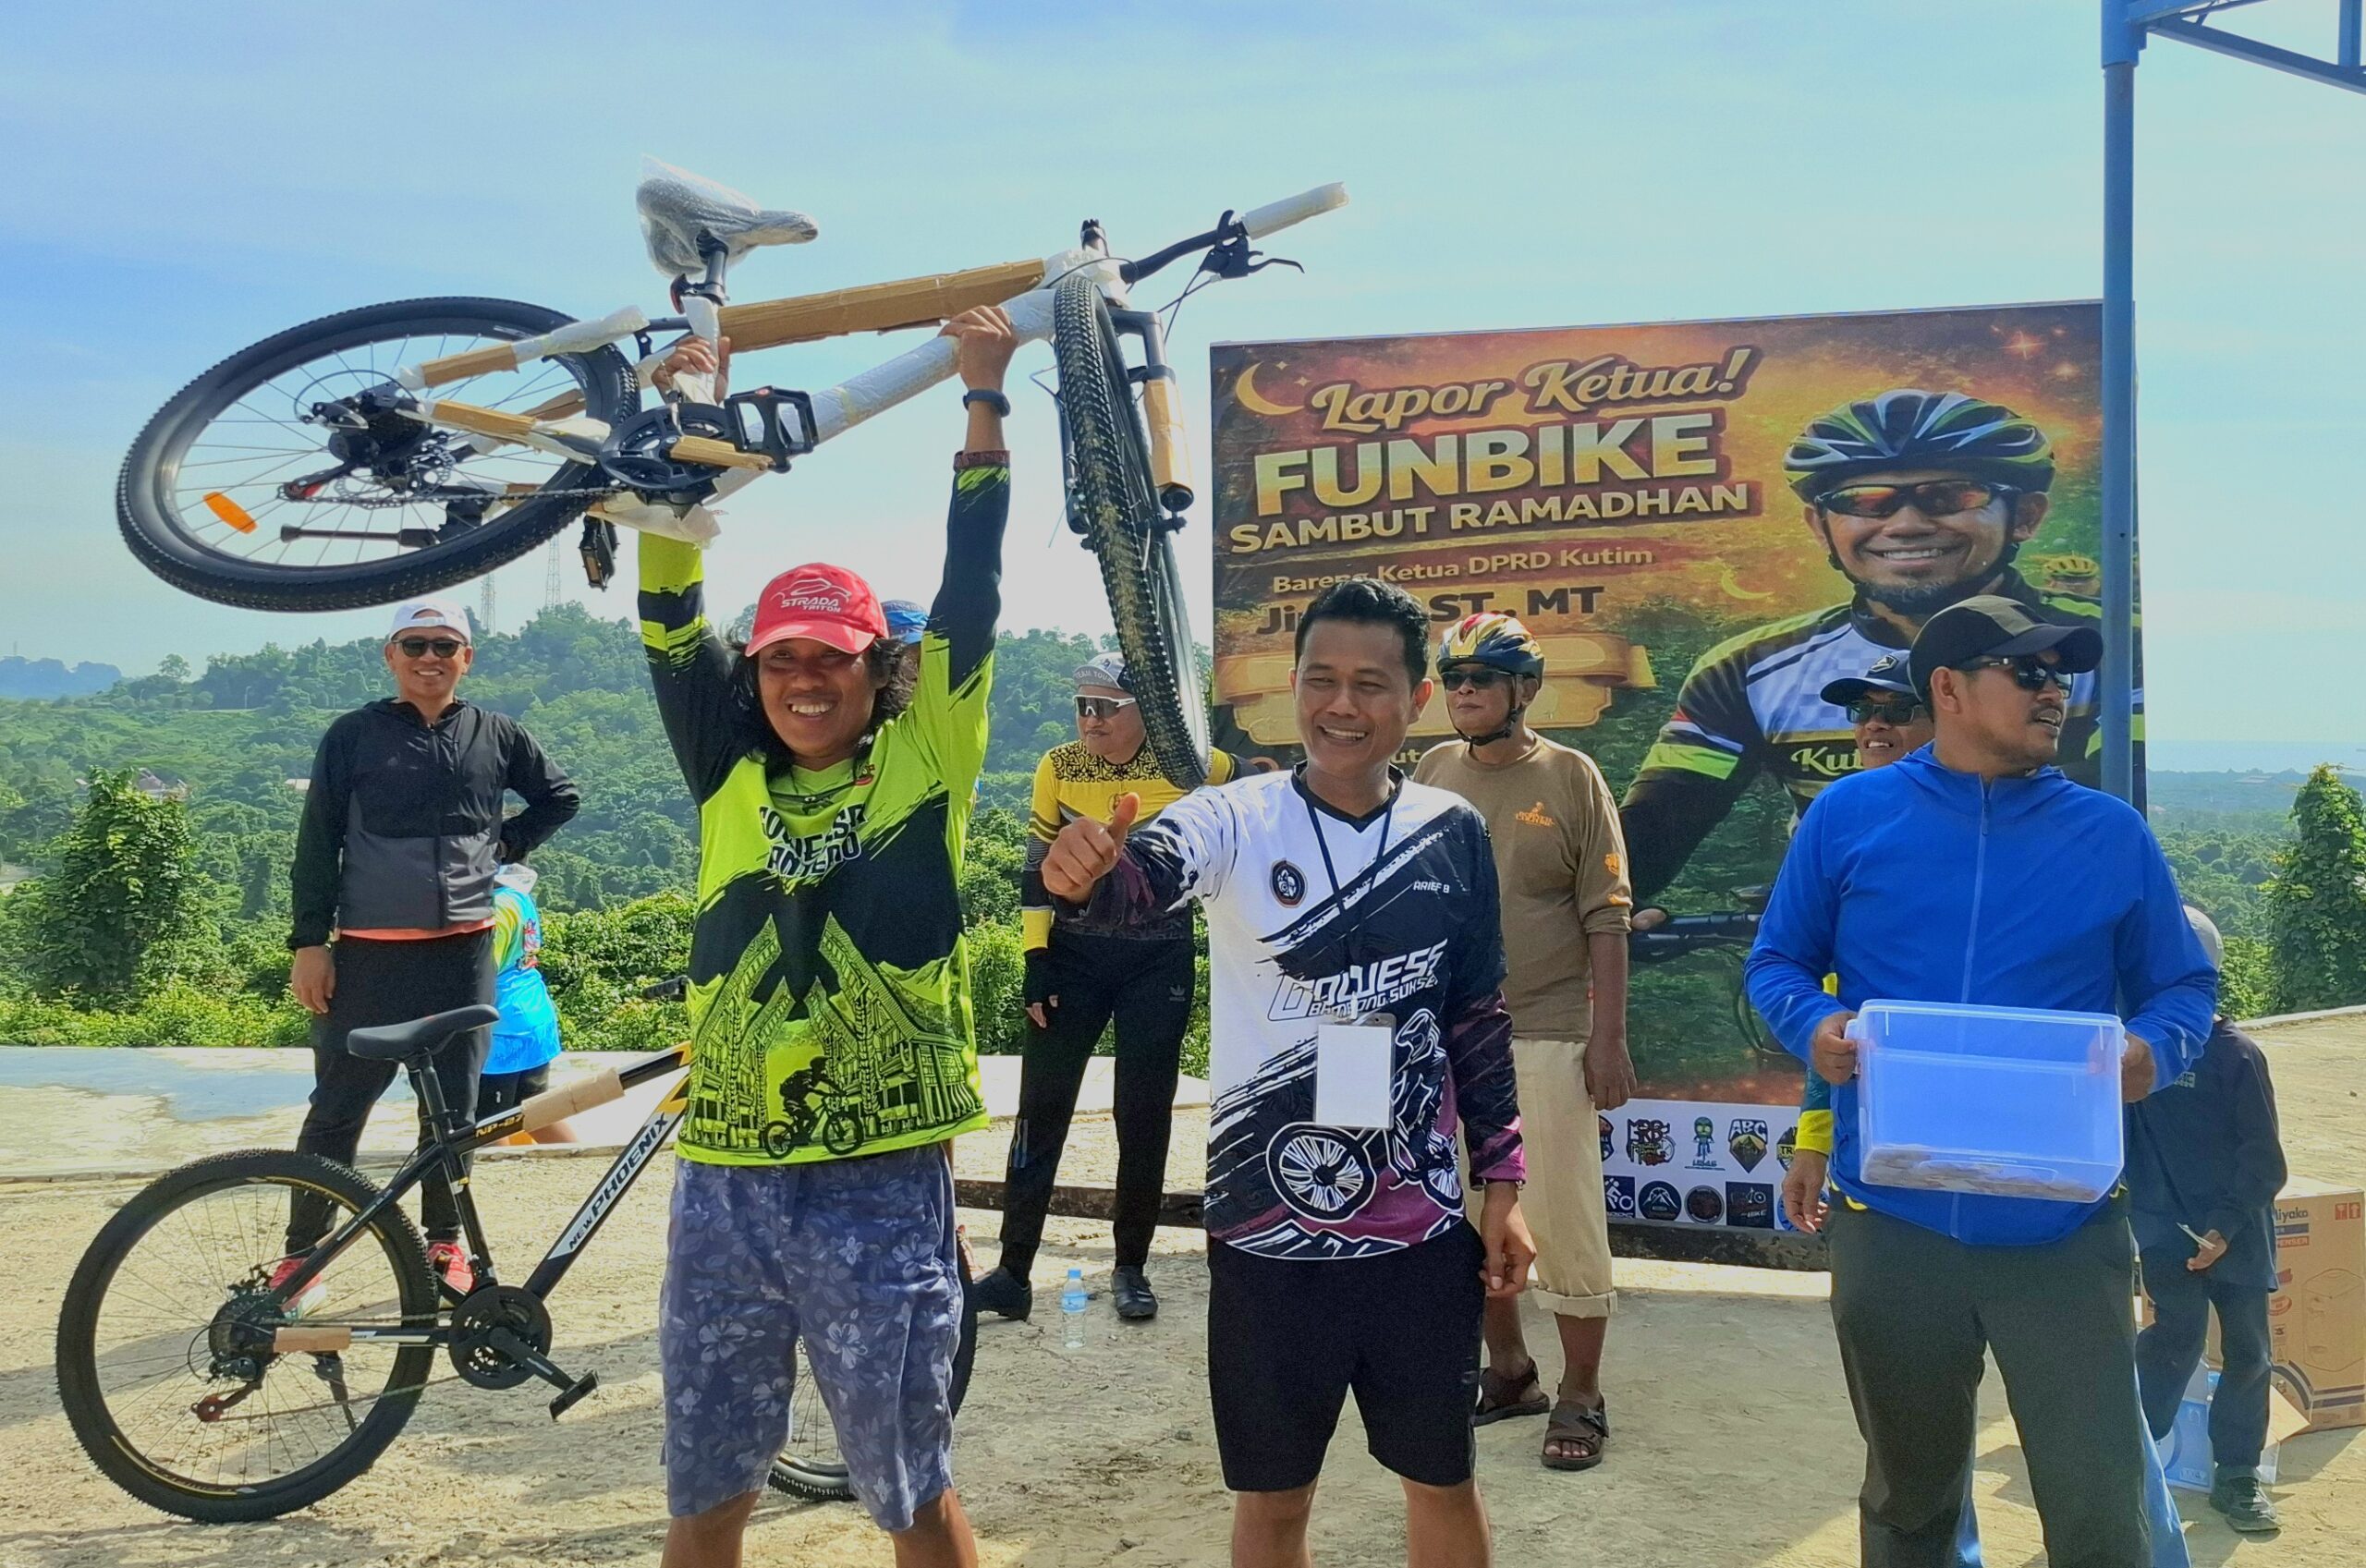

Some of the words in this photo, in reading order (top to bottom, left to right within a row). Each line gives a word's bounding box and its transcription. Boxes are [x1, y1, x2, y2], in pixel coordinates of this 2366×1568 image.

[1311, 378, 1506, 432] Lapor
[1524, 348, 1752, 412] Ketua!
[1254, 413, 1718, 516] FUNBIKE
[1230, 505, 1437, 553] SAMBUT
[1450, 483, 1750, 529] RAMADHAN
[1377, 563, 1460, 583] Ketua
[1469, 552, 1552, 575] DPRD
[1560, 547, 1653, 567] Kutim
[781, 597, 839, 608] STRADA
[802, 604, 841, 613] TRITON
[1527, 586, 1605, 616] MT
[1791, 746, 1862, 776] Kut
[1729, 1119, 1767, 1144] ABC
[1779, 1146, 1794, 1155] TR
[568, 1216, 594, 1249] NEW
[591, 1112, 669, 1219] PHOENIX
